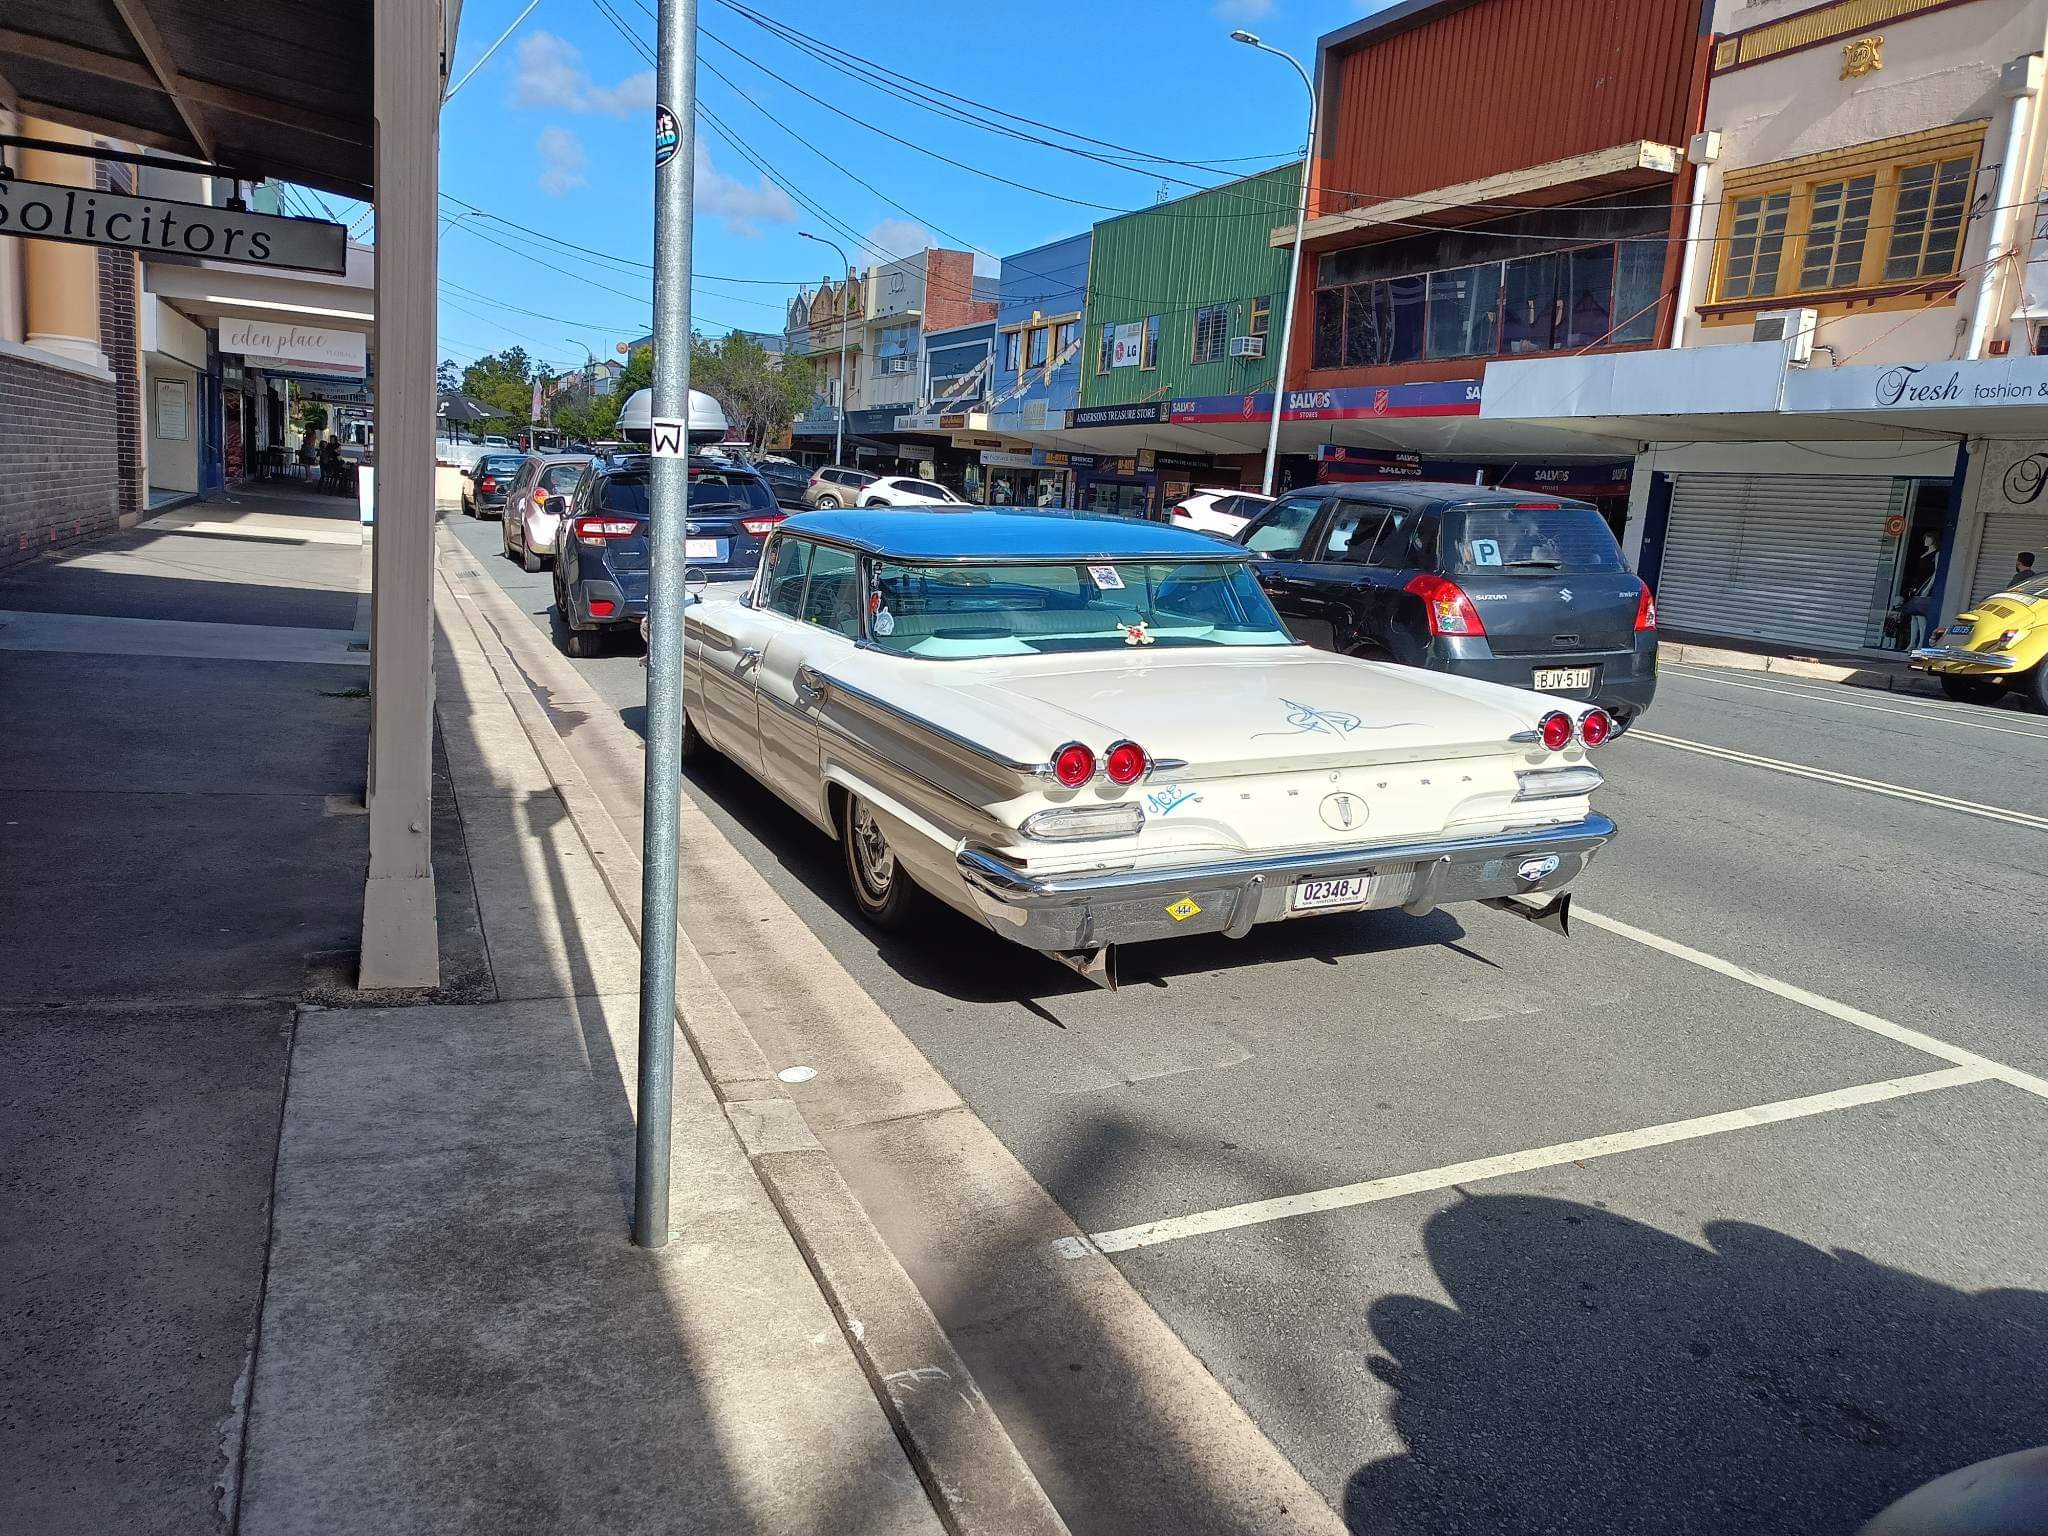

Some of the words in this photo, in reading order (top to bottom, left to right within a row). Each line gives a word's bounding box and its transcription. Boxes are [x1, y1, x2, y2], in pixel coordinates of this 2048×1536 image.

[0, 182, 272, 260] olicitors
[231, 322, 274, 347] eden
[277, 327, 328, 354] place
[1127, 344, 1137, 358] LG
[1876, 363, 1964, 406] Fresh
[1974, 383, 2032, 399] fashion
[2037, 382, 2048, 397] &
[1173, 401, 1196, 413] SALVOS
[1290, 391, 1331, 410] SALVOS
[1076, 411, 1107, 424] ANDERSONS
[1107, 409, 1137, 421] TREASURE
[1137, 407, 1156, 419] STORE
[1396, 453, 1420, 463] SALVOS
[1534, 470, 1570, 481] SALVOS
[1478, 543, 1495, 562] P
